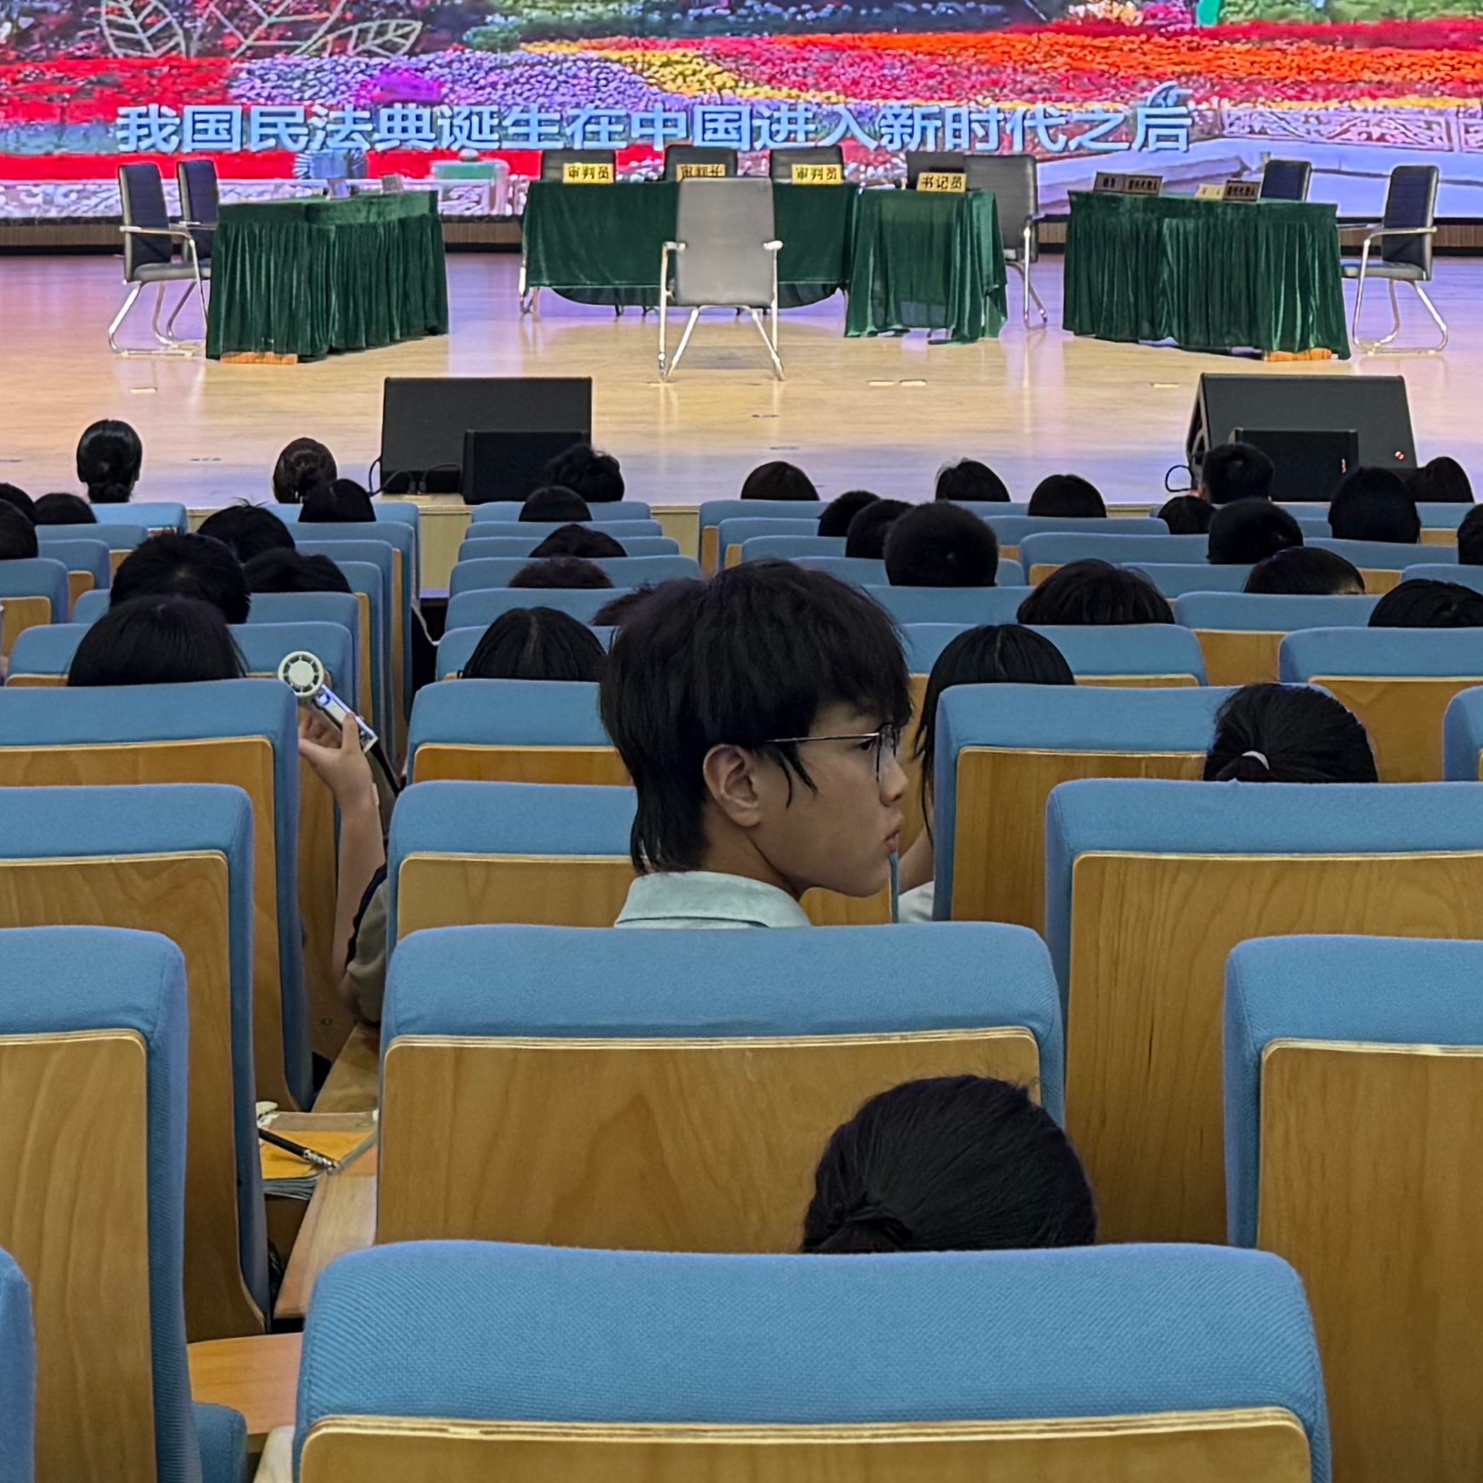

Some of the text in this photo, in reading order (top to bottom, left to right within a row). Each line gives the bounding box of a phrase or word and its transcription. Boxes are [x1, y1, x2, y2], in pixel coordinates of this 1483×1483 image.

[116, 103, 1192, 153] 我国民法典诞生在中国进入新时代之后
[567, 165, 609, 180] 审判员
[796, 166, 837, 180] 审判员
[922, 175, 962, 190] 书记员
